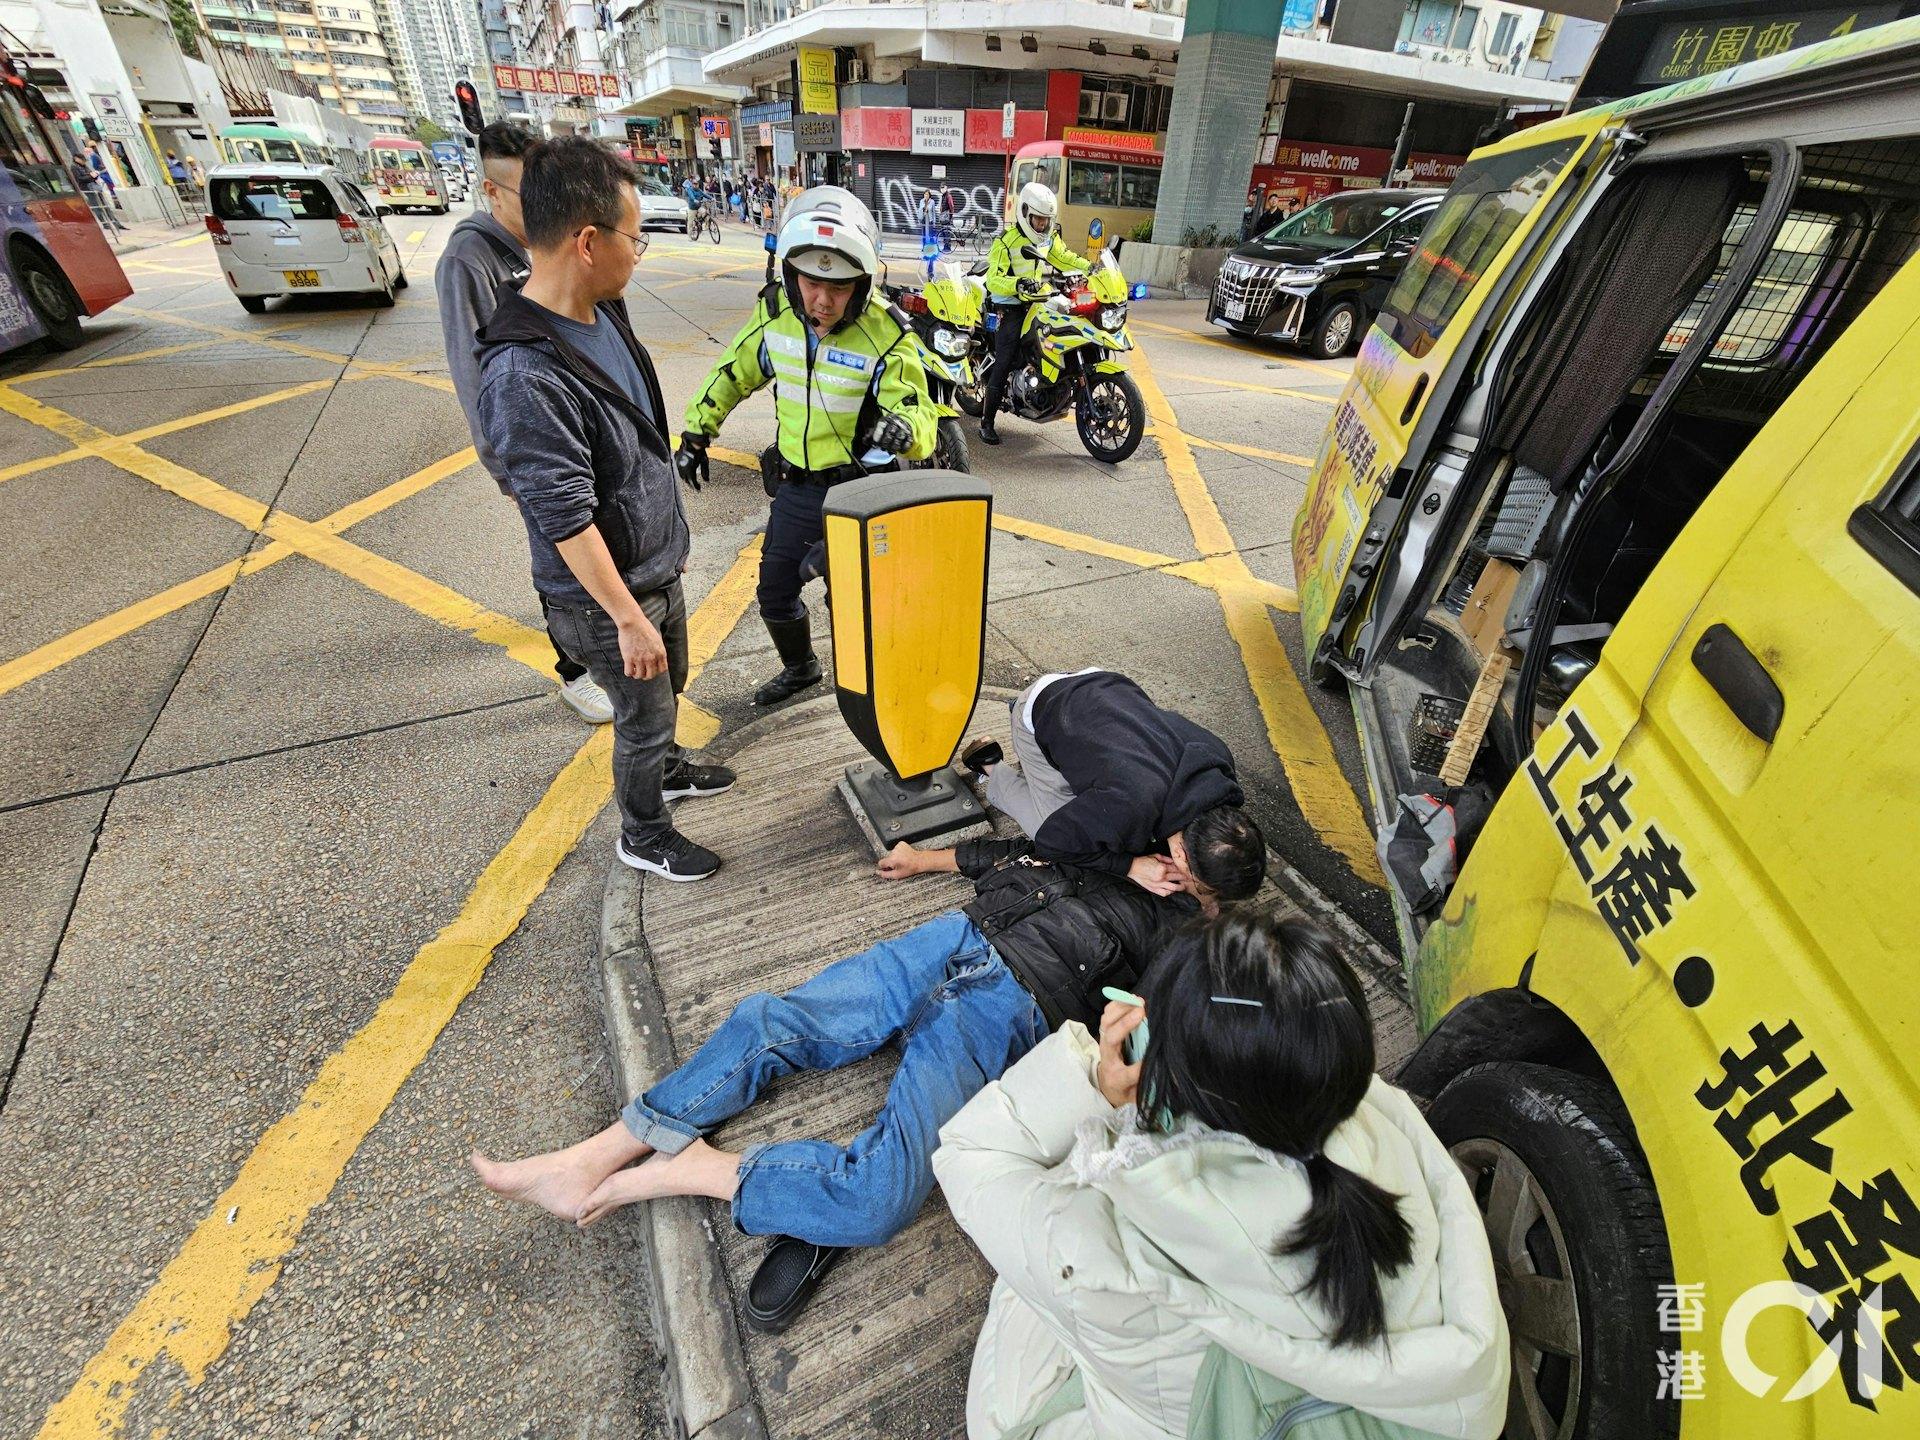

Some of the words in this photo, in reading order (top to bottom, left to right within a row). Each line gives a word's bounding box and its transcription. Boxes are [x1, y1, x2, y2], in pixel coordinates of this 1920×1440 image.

[1670, 21, 1801, 66] 竹園邨
[1660, 64, 1692, 79] CHUK
[1110, 134, 1154, 151] CHANDRA
[1069, 149, 1086, 157] PUBLIC
[1277, 147, 1300, 166] 惠康
[1300, 150, 1360, 171] wellcome
[834, 353, 858, 367] POLICE
[1693, 1018, 1920, 1414] 批發
